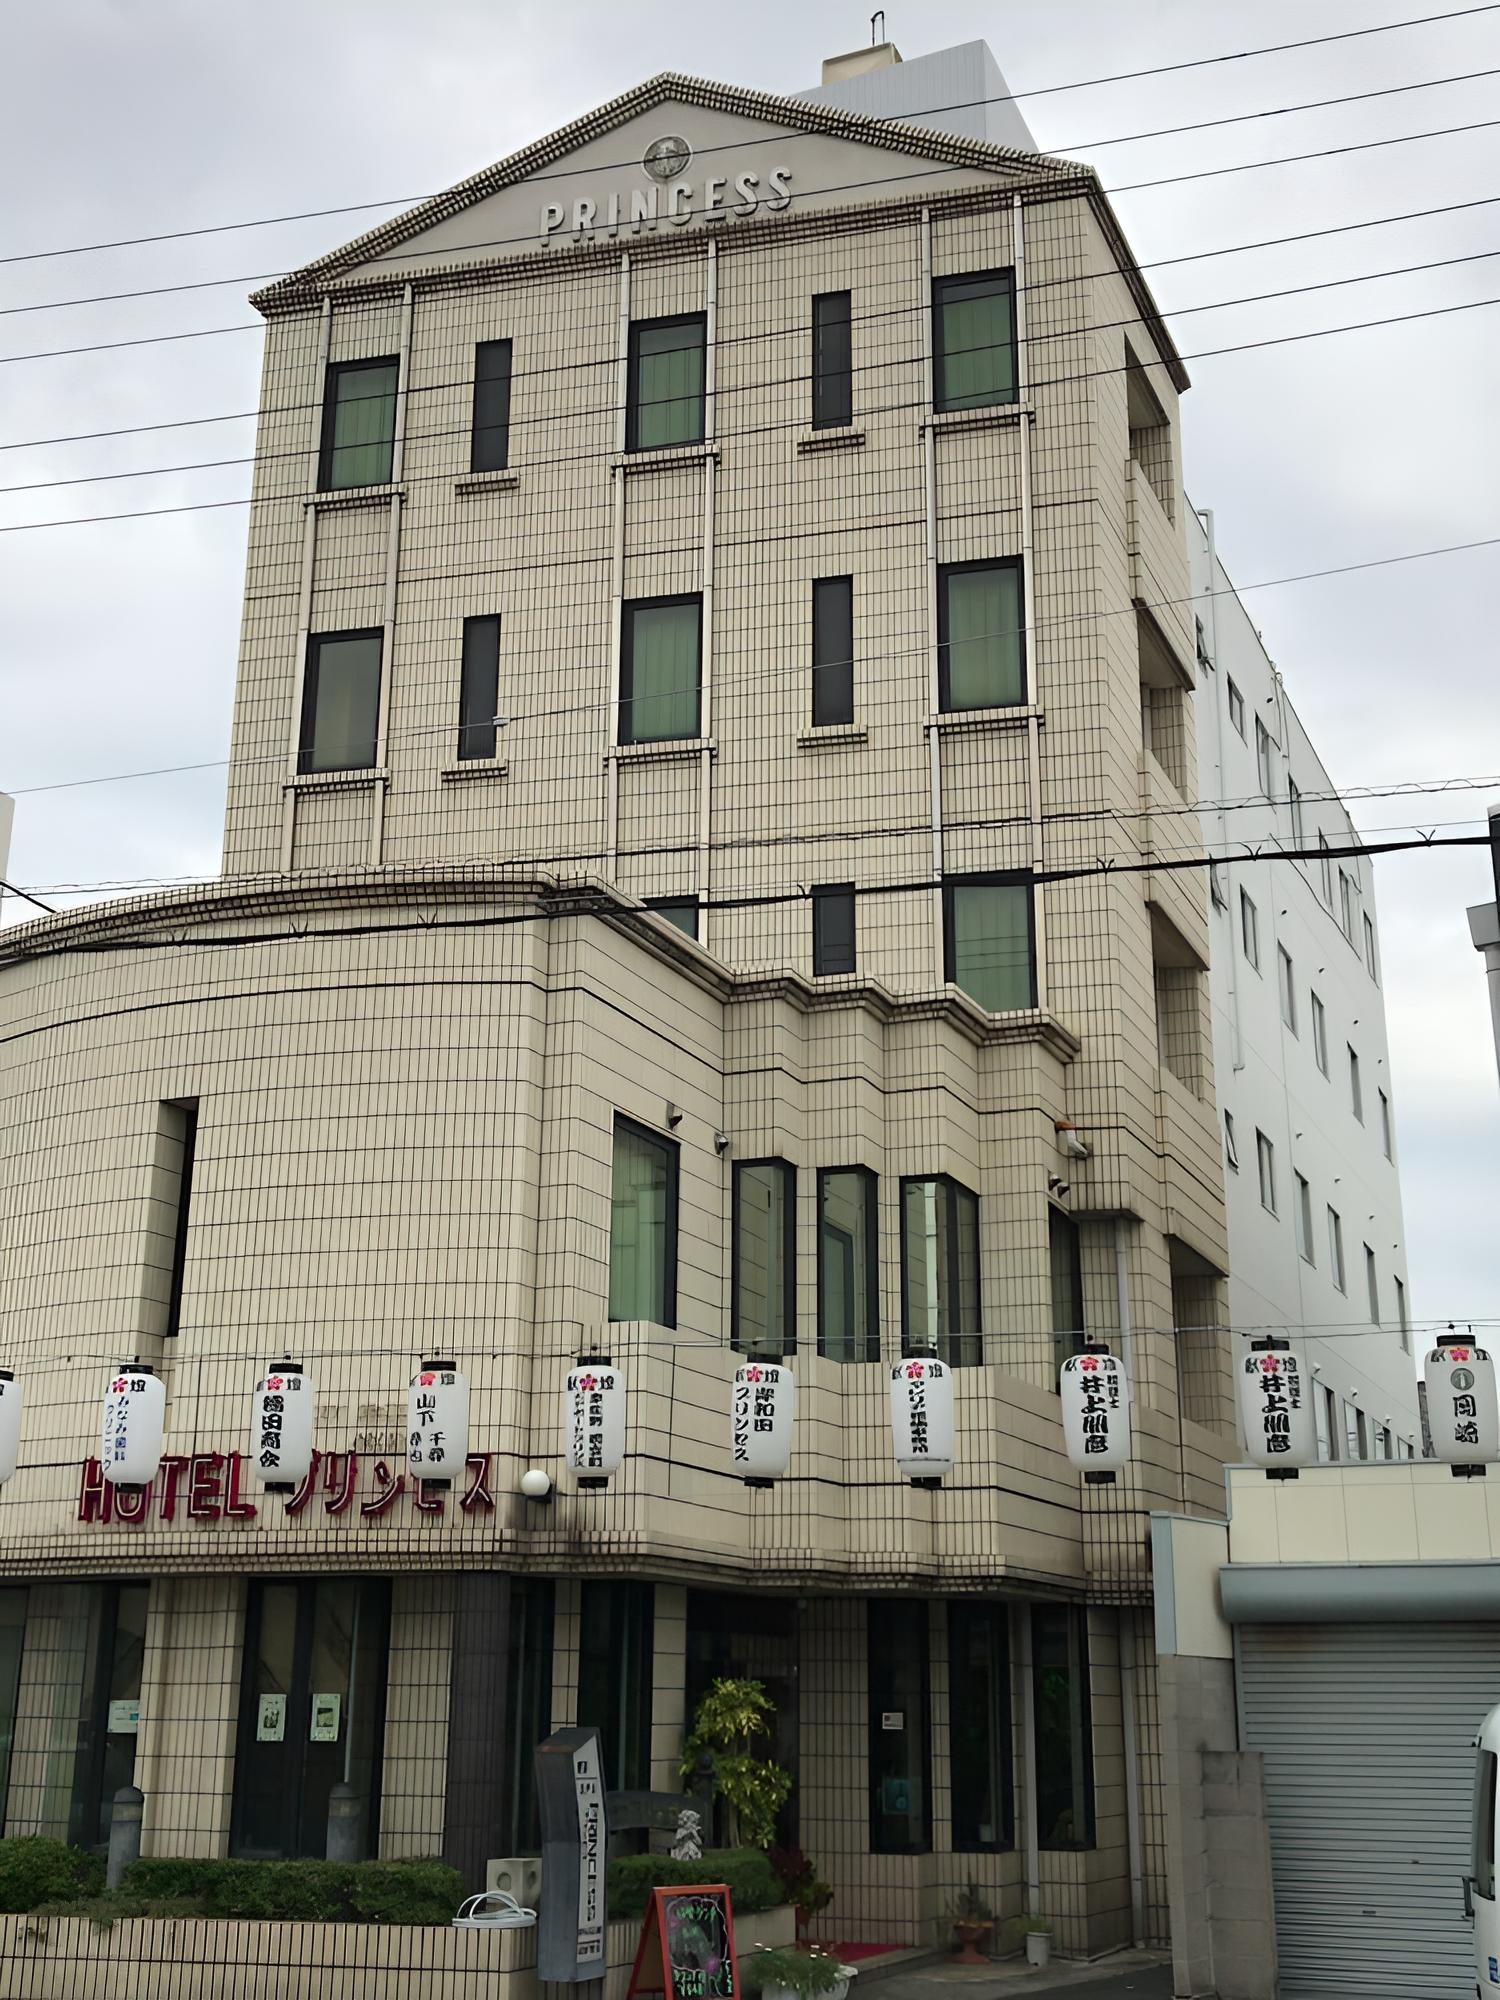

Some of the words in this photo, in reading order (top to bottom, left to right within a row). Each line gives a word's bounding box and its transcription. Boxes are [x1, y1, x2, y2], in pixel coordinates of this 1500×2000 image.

[539, 166, 792, 248] PRINCESS
[734, 1386, 750, 1462] プリンセス
[754, 1386, 775, 1432] 岸和田
